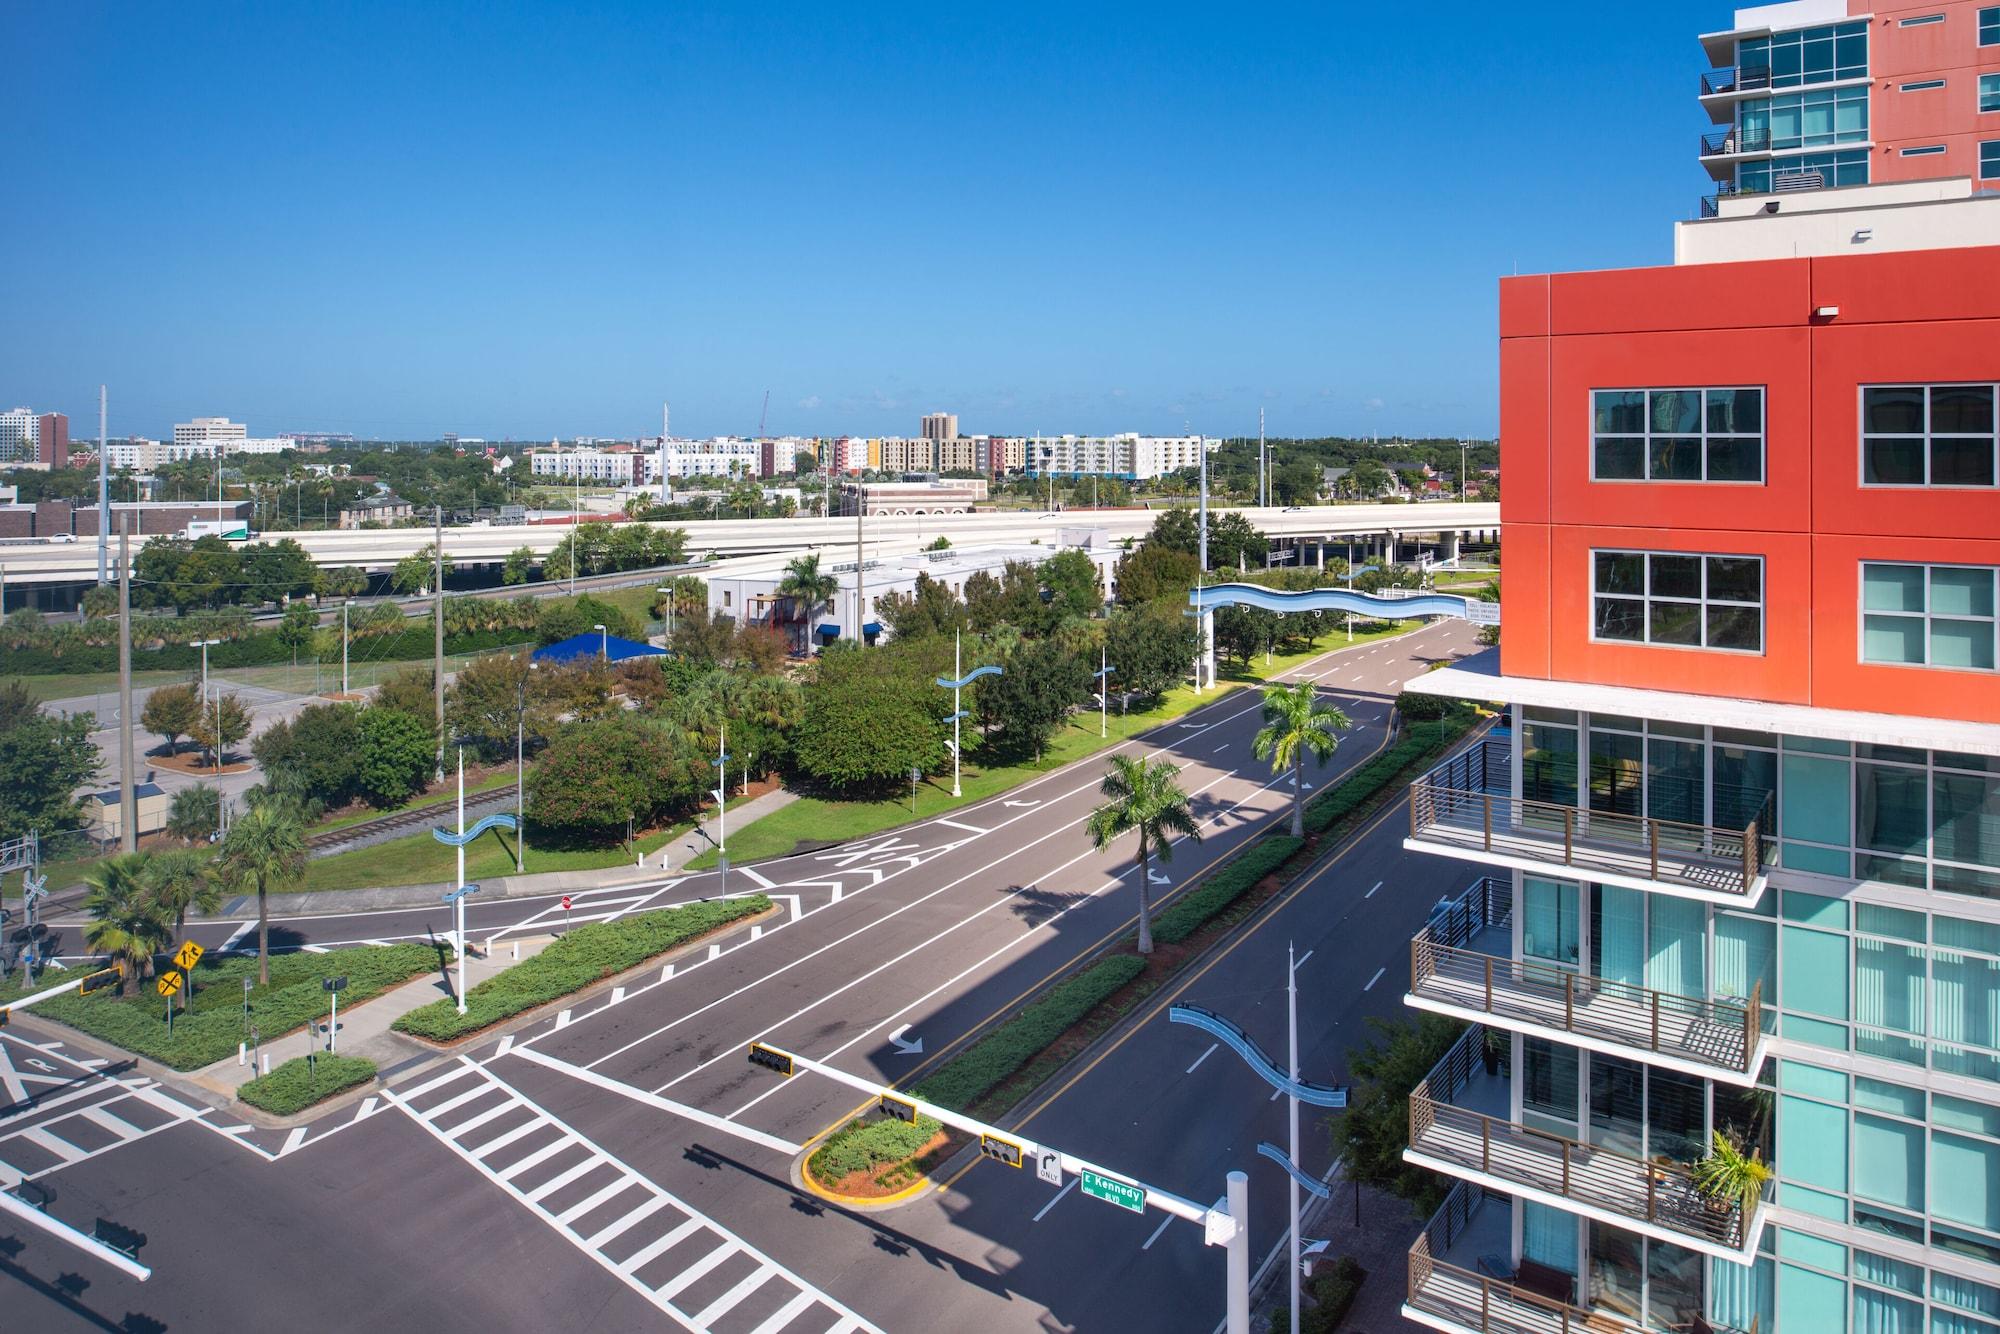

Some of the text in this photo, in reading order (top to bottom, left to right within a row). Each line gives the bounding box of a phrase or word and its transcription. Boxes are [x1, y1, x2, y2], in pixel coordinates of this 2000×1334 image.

[1040, 1169, 1058, 1182] ONLY
[1085, 1174, 1140, 1202] E Kennedy
[1104, 1192, 1120, 1204] BLVD
